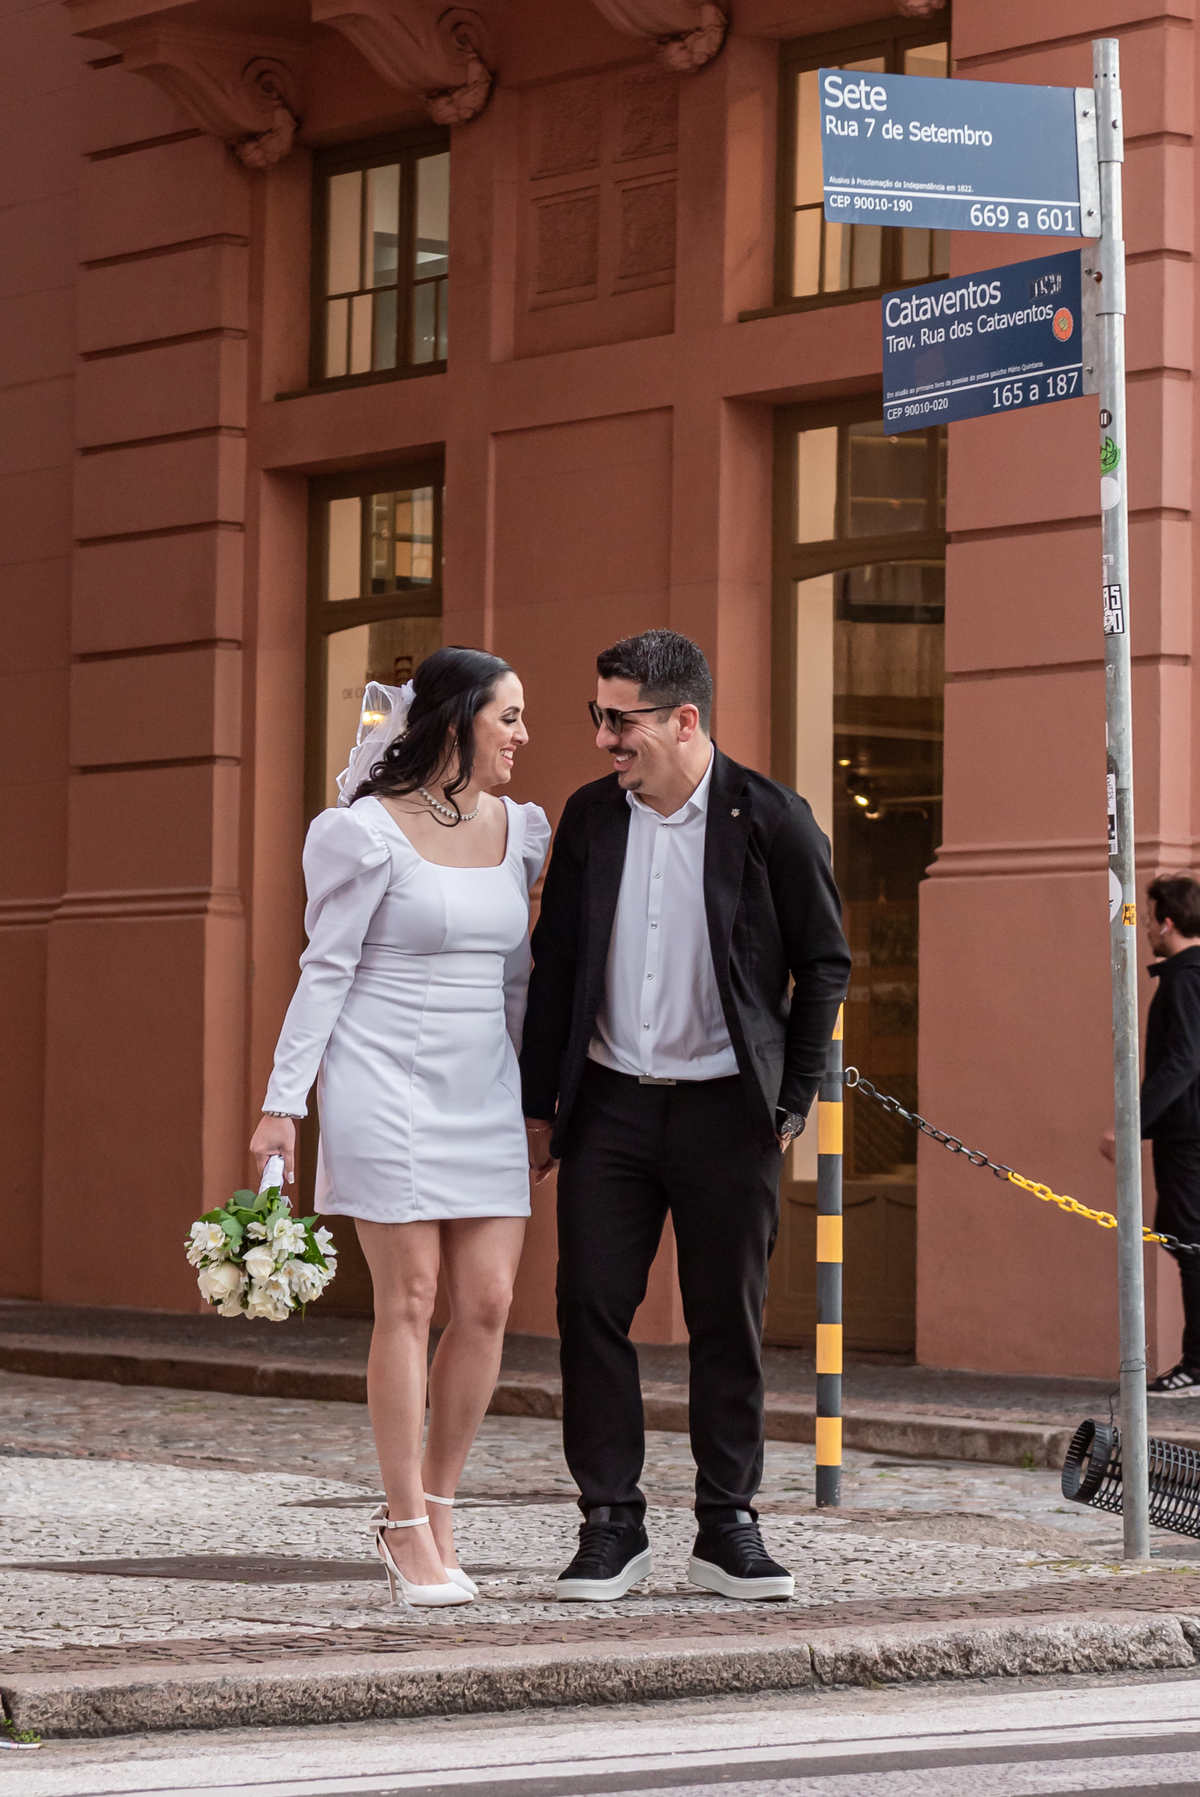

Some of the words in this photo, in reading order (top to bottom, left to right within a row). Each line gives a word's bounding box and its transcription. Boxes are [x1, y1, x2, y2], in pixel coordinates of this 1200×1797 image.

[824, 75, 887, 111] Sete
[825, 114, 859, 137] Rua
[864, 117, 876, 138] 7
[881, 118, 904, 140] de
[908, 121, 993, 147] Setembro
[829, 175, 850, 185] Alusivo
[857, 177, 893, 188] Proclamação
[894, 179, 902, 188] da
[903, 180, 945, 191] Independência
[957, 184, 974, 193] 1822.
[829, 194, 851, 208] CEP
[853, 196, 913, 212] 90010-190
[970, 203, 1009, 228] 669
[1017, 211, 1029, 229] a
[1037, 207, 1075, 232] 601
[885, 281, 1002, 328] Cataventos
[886, 334, 916, 354] Trav.
[921, 327, 945, 346] Rua
[949, 320, 974, 340] dos
[976, 304, 1054, 334] Cataventos
[935, 381, 945, 389] livro
[969, 374, 976, 382] do
[976, 372, 990, 381] poeta
[992, 382, 1023, 408] 165
[1029, 383, 1039, 401] a
[1046, 371, 1078, 398] 187
[887, 407, 903, 420] CEP
[904, 397, 949, 417] 90010-020
